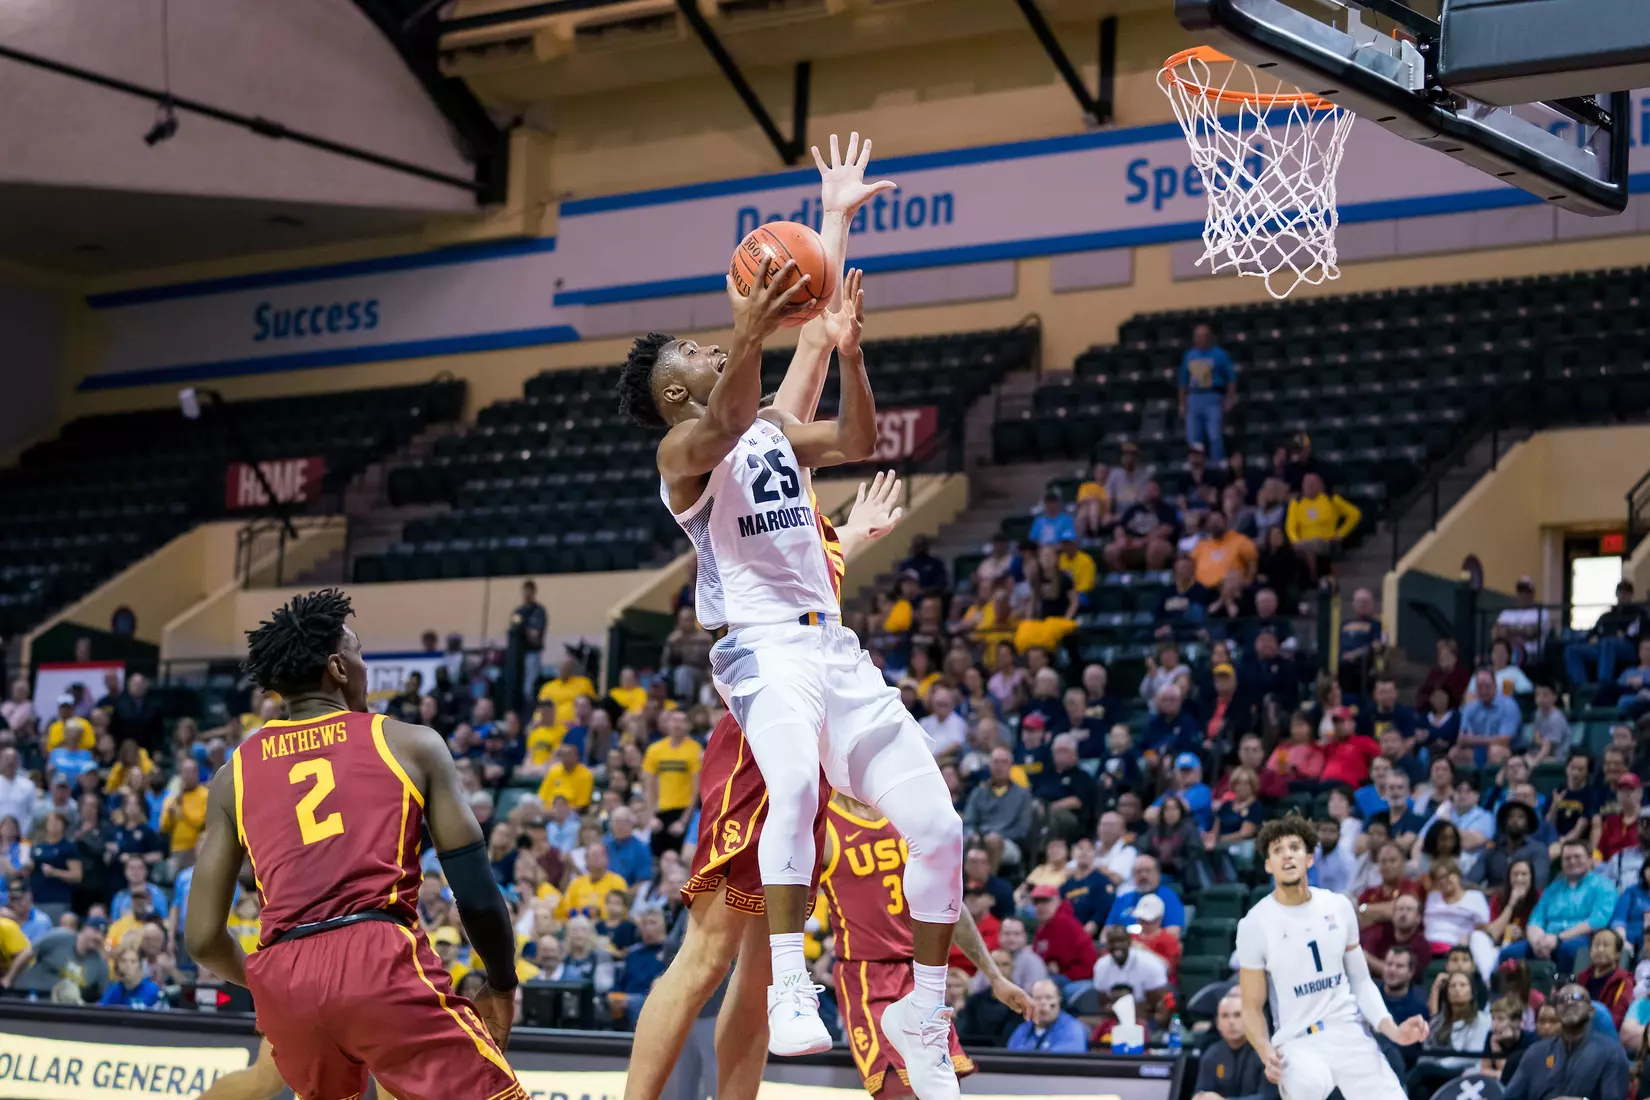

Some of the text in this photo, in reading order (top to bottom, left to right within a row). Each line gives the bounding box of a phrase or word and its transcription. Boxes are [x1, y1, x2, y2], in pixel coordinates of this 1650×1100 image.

[736, 187, 955, 250] Ddiation
[253, 300, 379, 342] Success
[747, 448, 800, 504] 25
[261, 721, 347, 761] MATHEWS
[288, 757, 345, 846] 2
[882, 874, 904, 916] 3
[1307, 940, 1323, 972] 1
[0, 1053, 83, 1087] OLLAR
